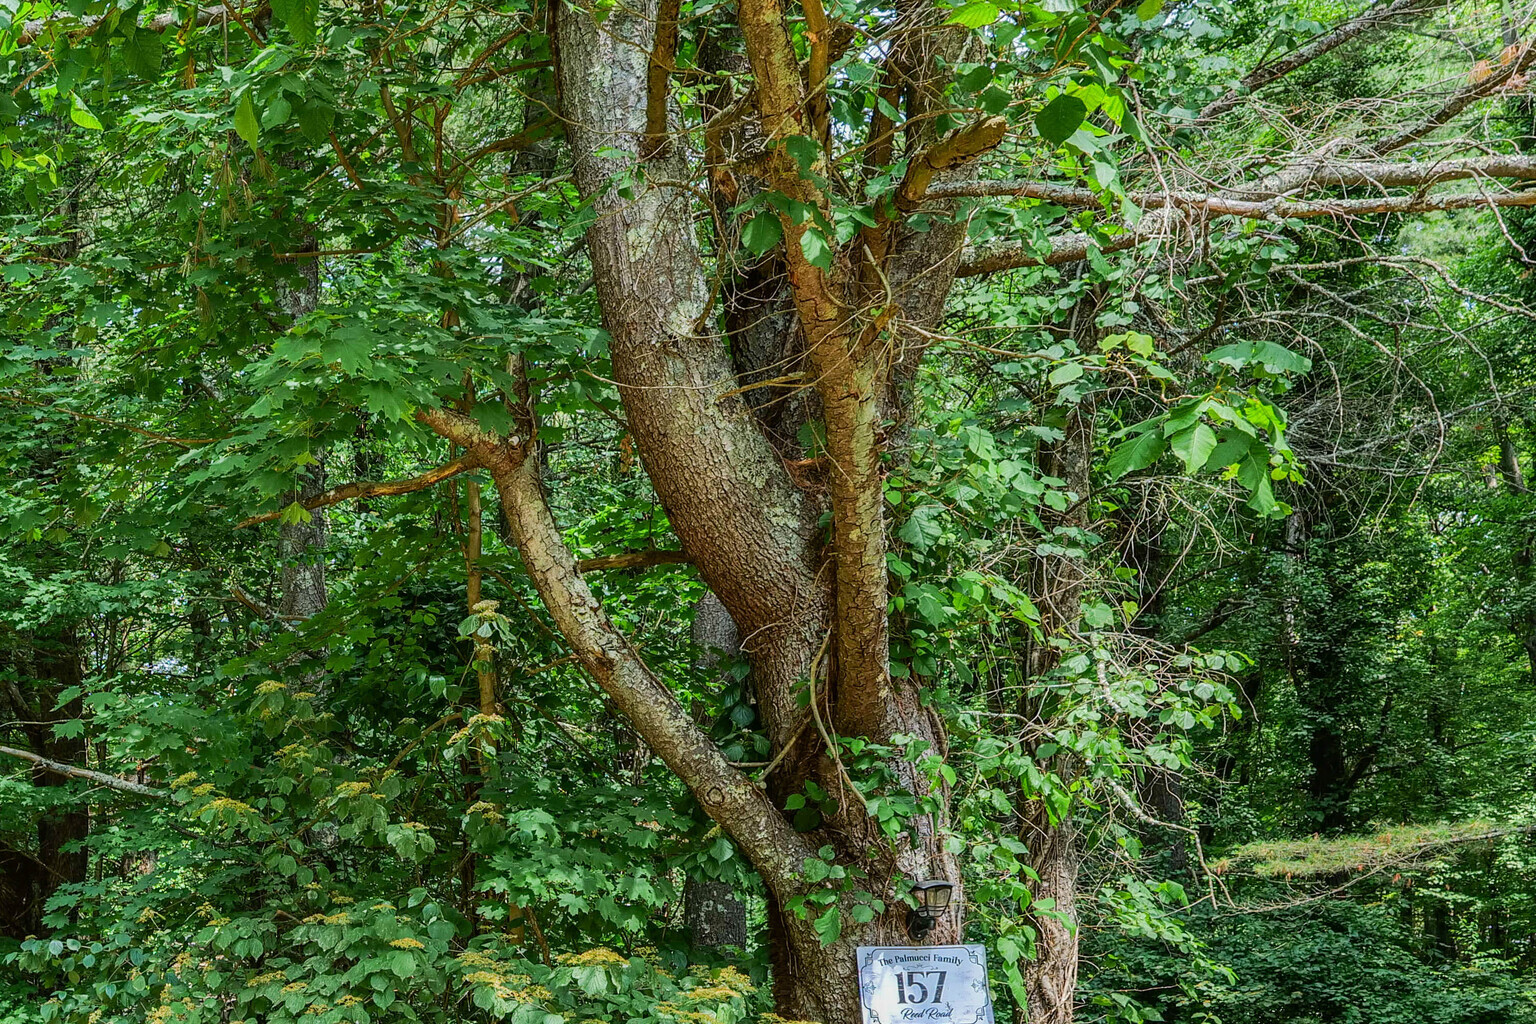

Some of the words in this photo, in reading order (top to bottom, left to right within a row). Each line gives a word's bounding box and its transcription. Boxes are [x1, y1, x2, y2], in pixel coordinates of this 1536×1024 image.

[878, 958, 893, 967] The
[894, 954, 931, 963] Palmucci
[933, 954, 963, 966] Family
[894, 971, 947, 1004] 157
[901, 1007, 924, 1020] Reed
[925, 1007, 953, 1020] Road
